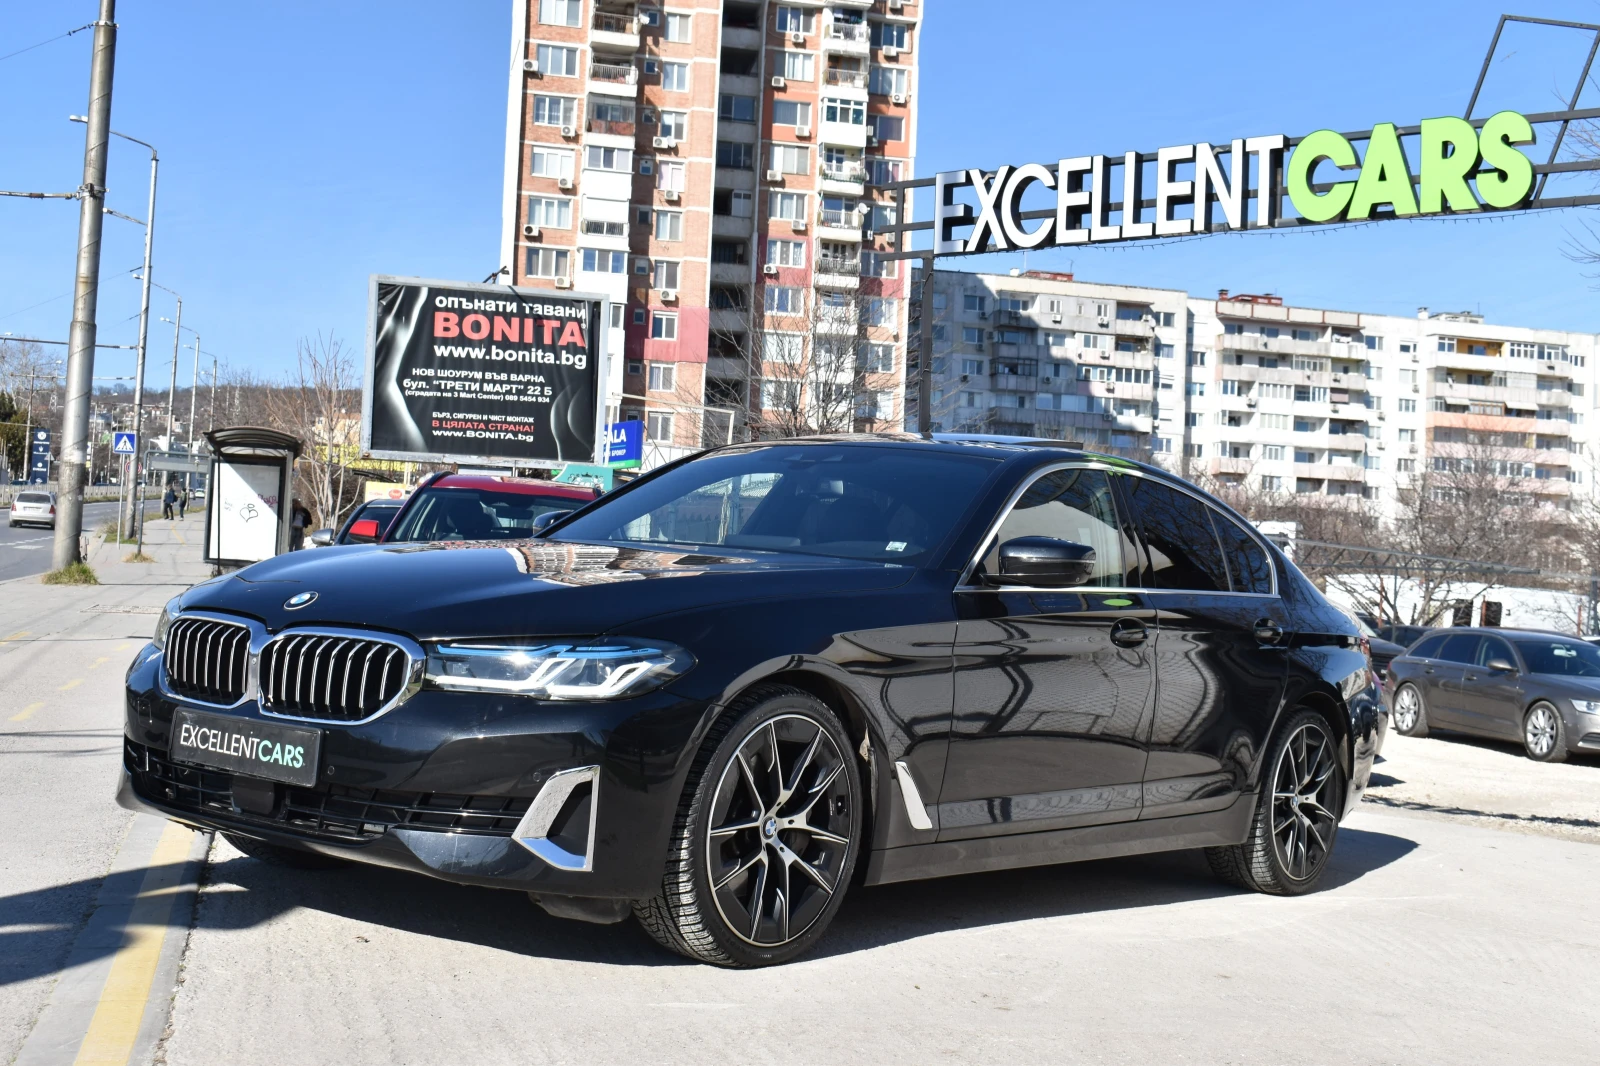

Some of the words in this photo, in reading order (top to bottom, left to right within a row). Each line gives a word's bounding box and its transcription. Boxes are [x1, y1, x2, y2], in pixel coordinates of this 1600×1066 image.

[934, 111, 1535, 255] EXCELLENTCARS
[435, 296, 517, 313] опънати
[523, 303, 586, 319] тавани
[434, 312, 586, 347] BONITA
[434, 345, 586, 369] www.bonita.bg
[412, 368, 435, 376] НОВ
[437, 370, 482, 379] ШОУРУМ
[485, 372, 508, 380] ВЪВ
[510, 374, 546, 383] ВАРНА
[403, 379, 429, 390] бул.
[527, 386, 540, 395] 22
[544, 387, 552, 396] Б
[477, 393, 503, 401] Center)
[432, 430, 534, 442] www.BONITA.bg
[443, 420, 485, 430] ЦЯЛАТА
[488, 423, 534, 432] СТРАНА!
[180, 724, 304, 768] EXCELLENTCARS
